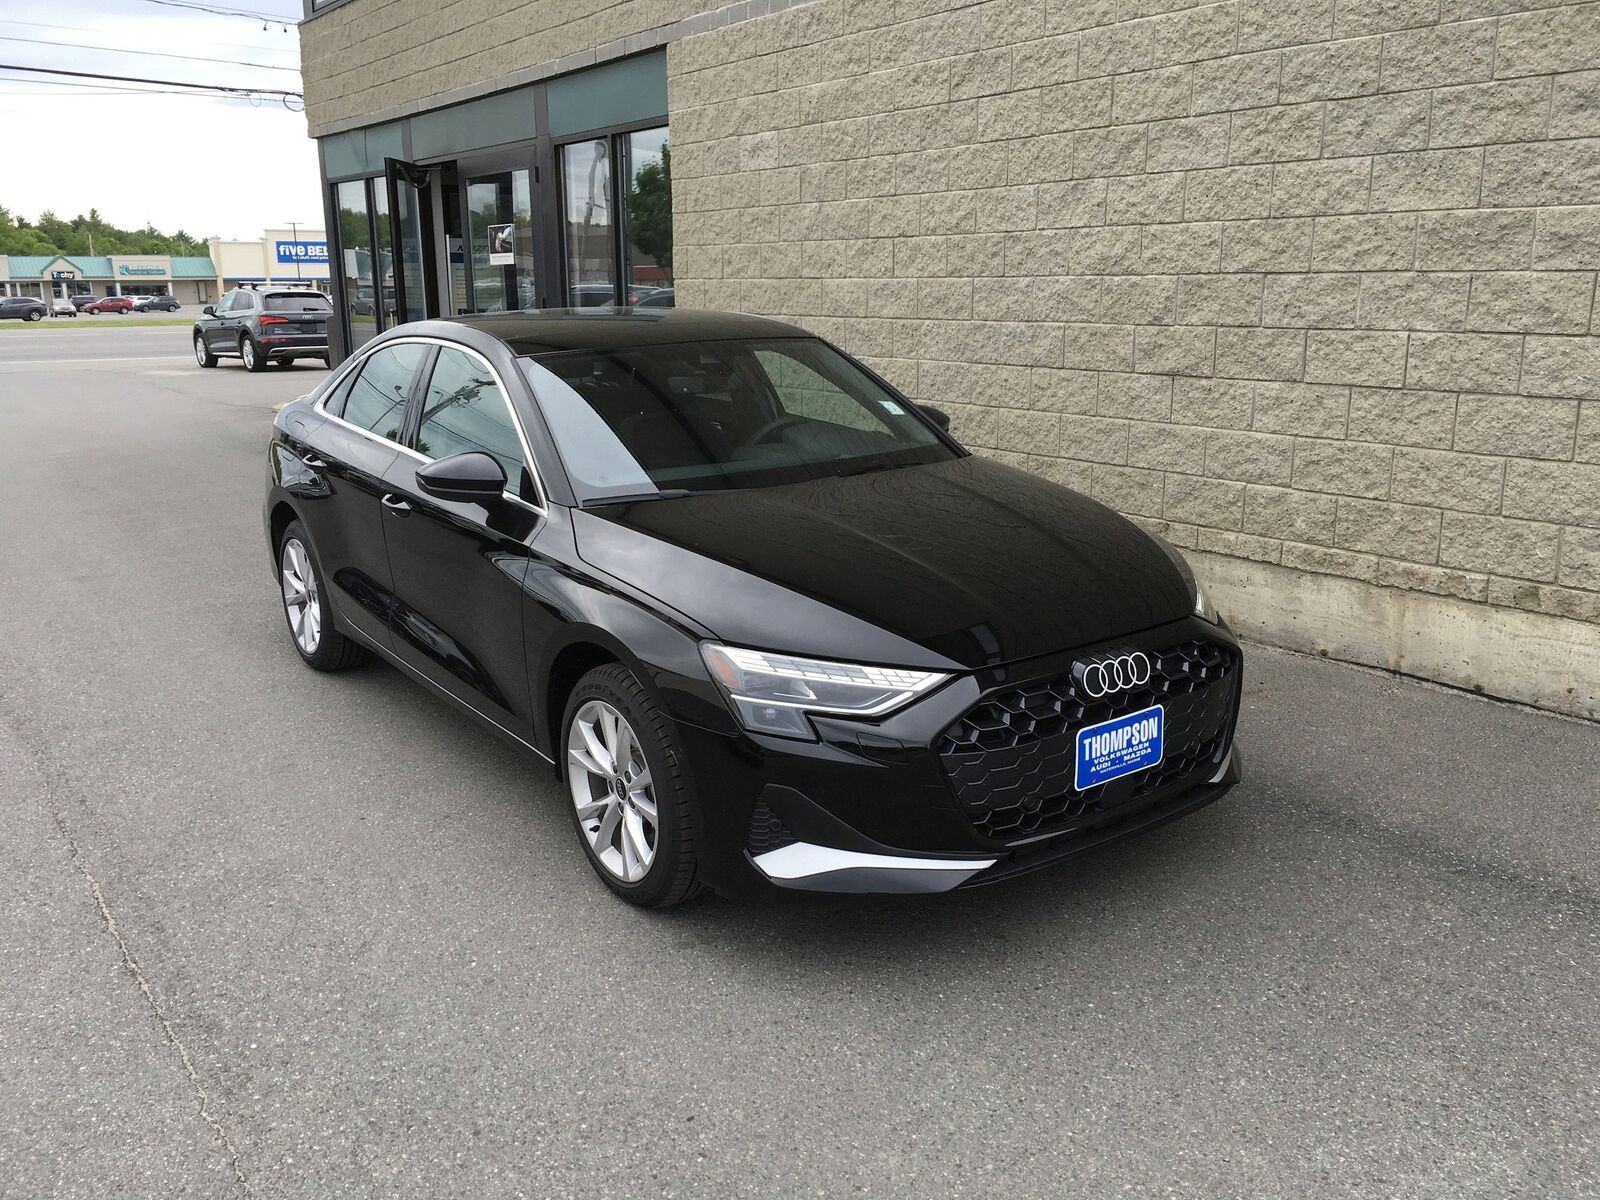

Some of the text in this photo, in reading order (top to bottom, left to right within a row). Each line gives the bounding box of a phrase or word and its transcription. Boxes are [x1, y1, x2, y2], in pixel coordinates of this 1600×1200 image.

[279, 245, 306, 256] five
[1083, 716, 1158, 761] THOMPSON
[1090, 747, 1152, 773] AUDI MAZDA
[1093, 741, 1150, 765] VOLKSWAGEN
